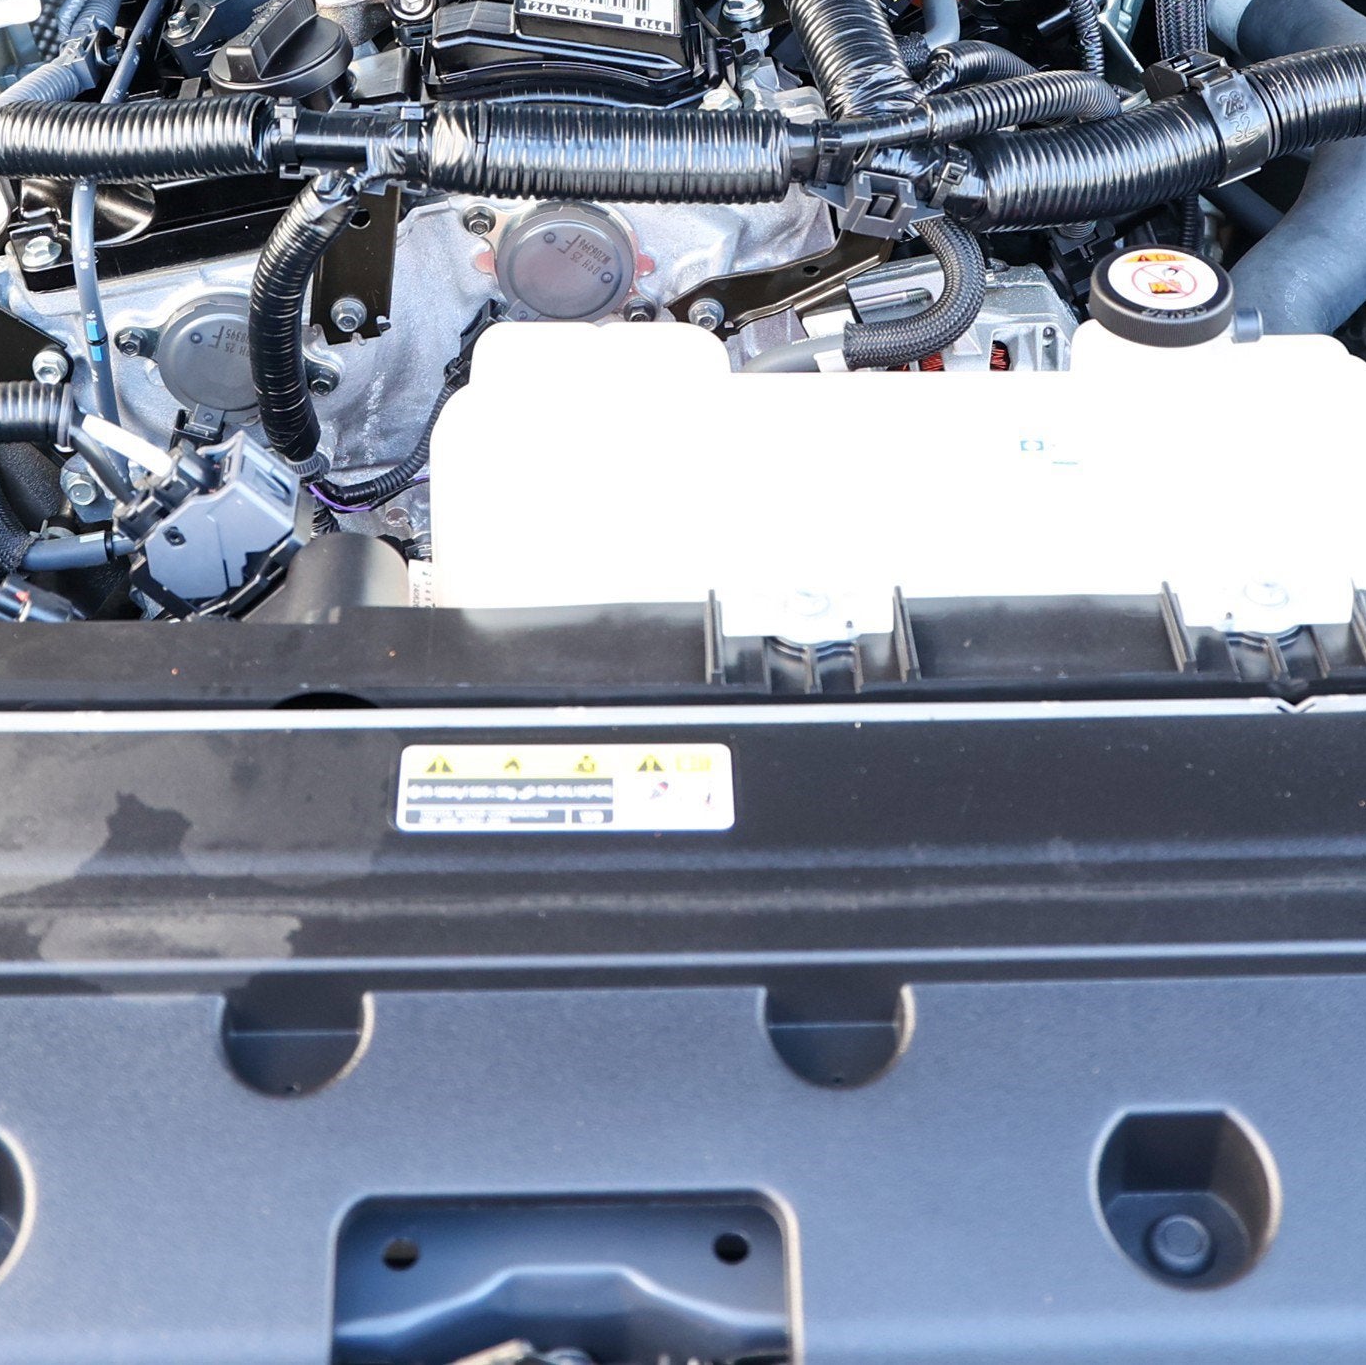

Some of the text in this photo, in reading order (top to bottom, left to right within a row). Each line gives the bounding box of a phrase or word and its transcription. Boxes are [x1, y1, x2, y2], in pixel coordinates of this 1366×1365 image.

[523, 0, 667, 32] T24A-T83 044
[557, 234, 582, 255] F
[1140, 304, 1208, 319] DENSO
[207, 325, 225, 349] F
